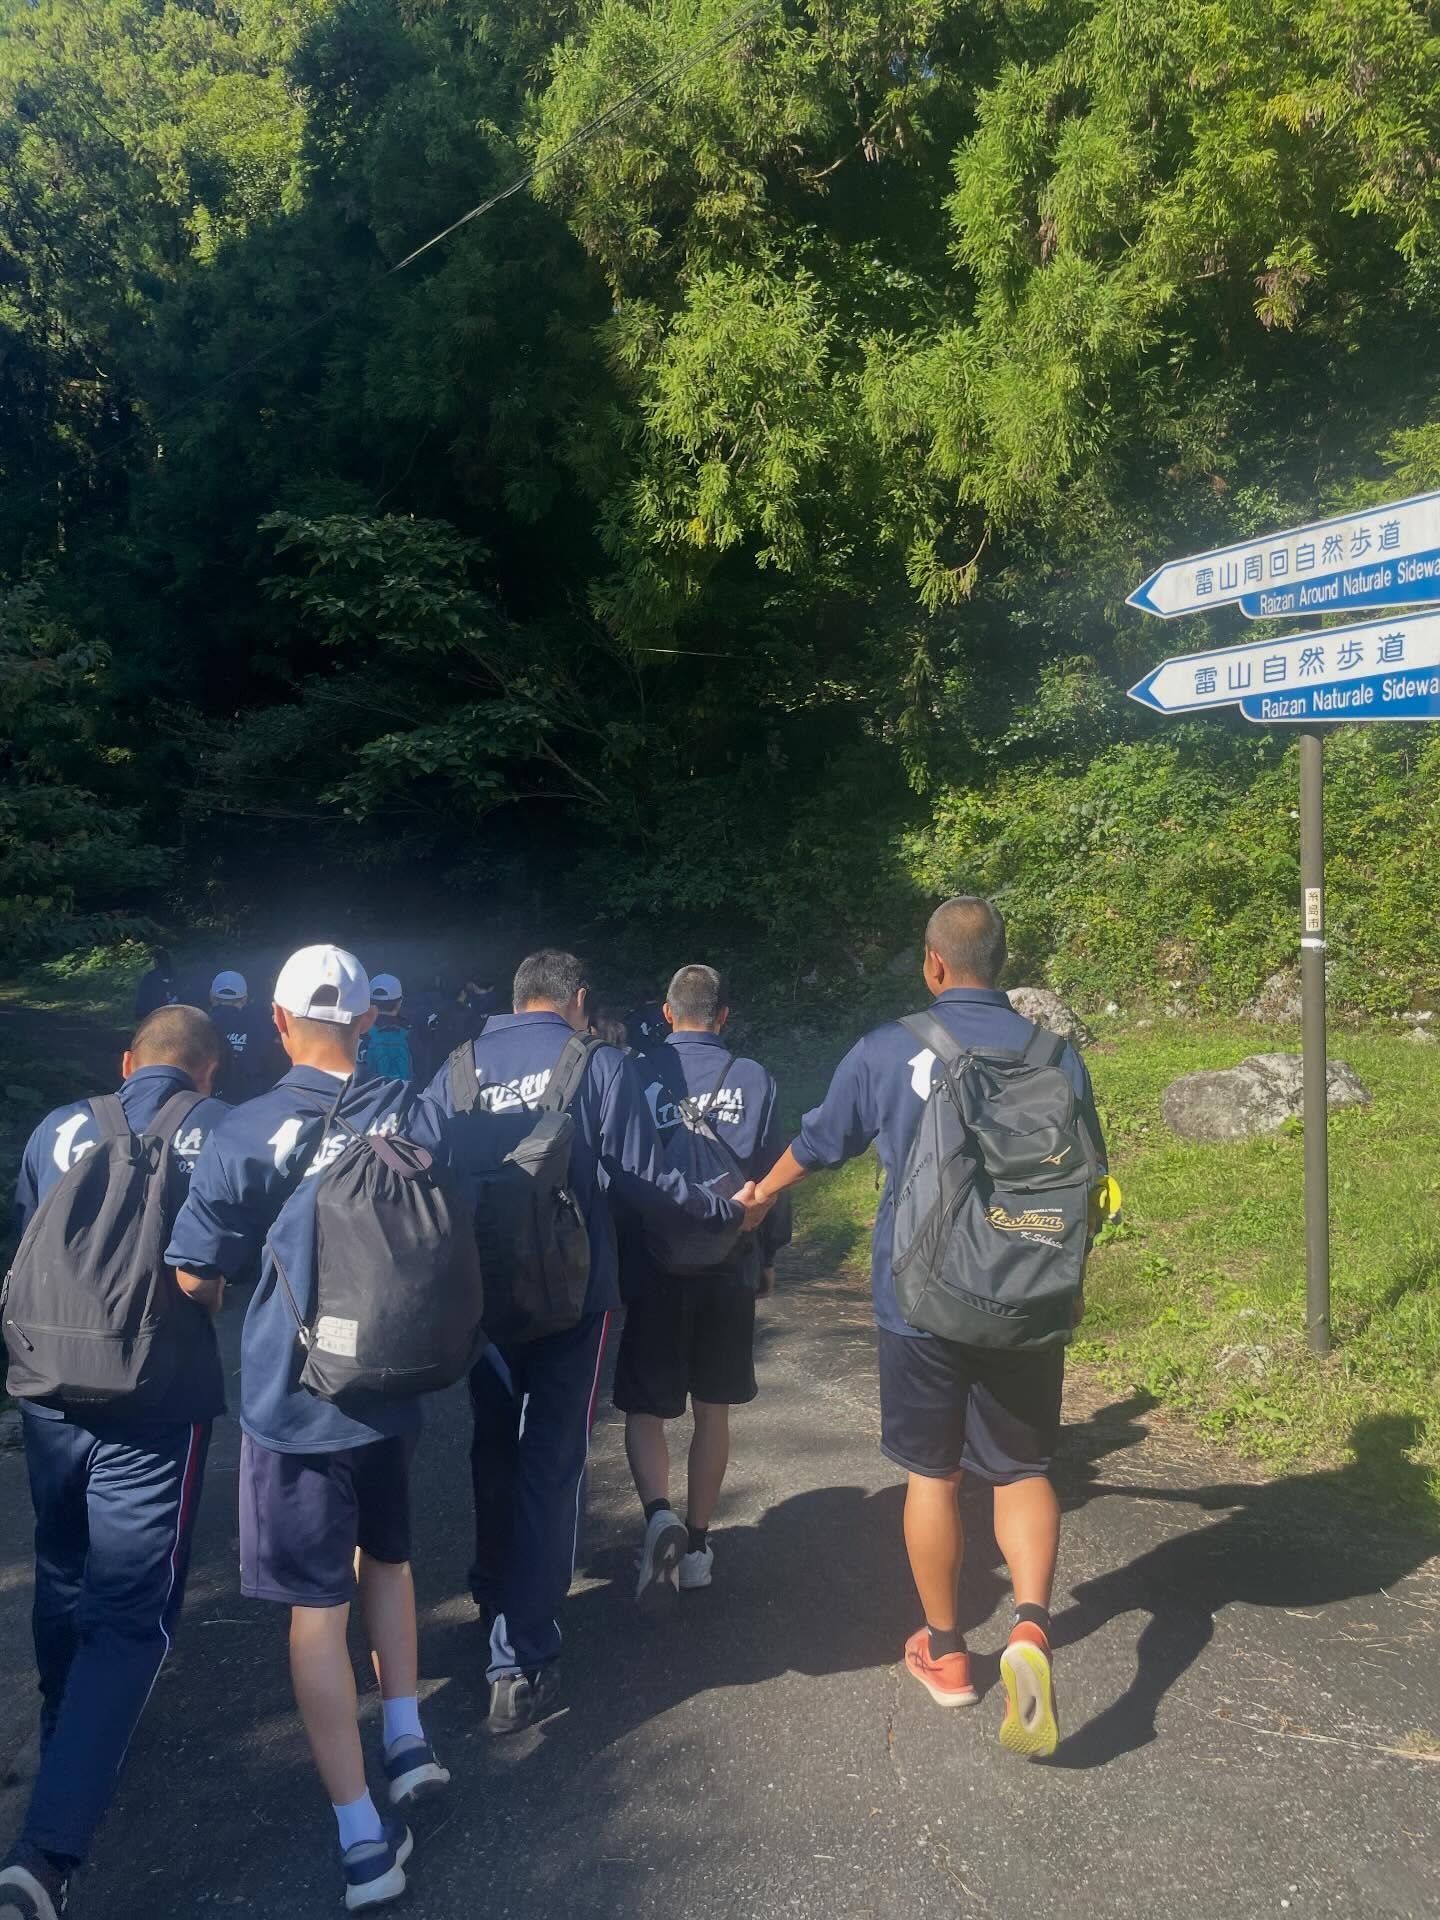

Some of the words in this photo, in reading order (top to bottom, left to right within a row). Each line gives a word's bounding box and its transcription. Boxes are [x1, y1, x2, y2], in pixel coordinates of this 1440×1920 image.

[1195, 519, 1401, 597] 雷山周回自然歩道
[1260, 592, 1295, 616] Raizan
[1300, 577, 1339, 607] Around
[1343, 565, 1392, 597] Naturale
[1194, 631, 1406, 696] 雷山自然歩道
[1261, 697, 1307, 720] Raizan
[1312, 684, 1374, 711] Naturale
